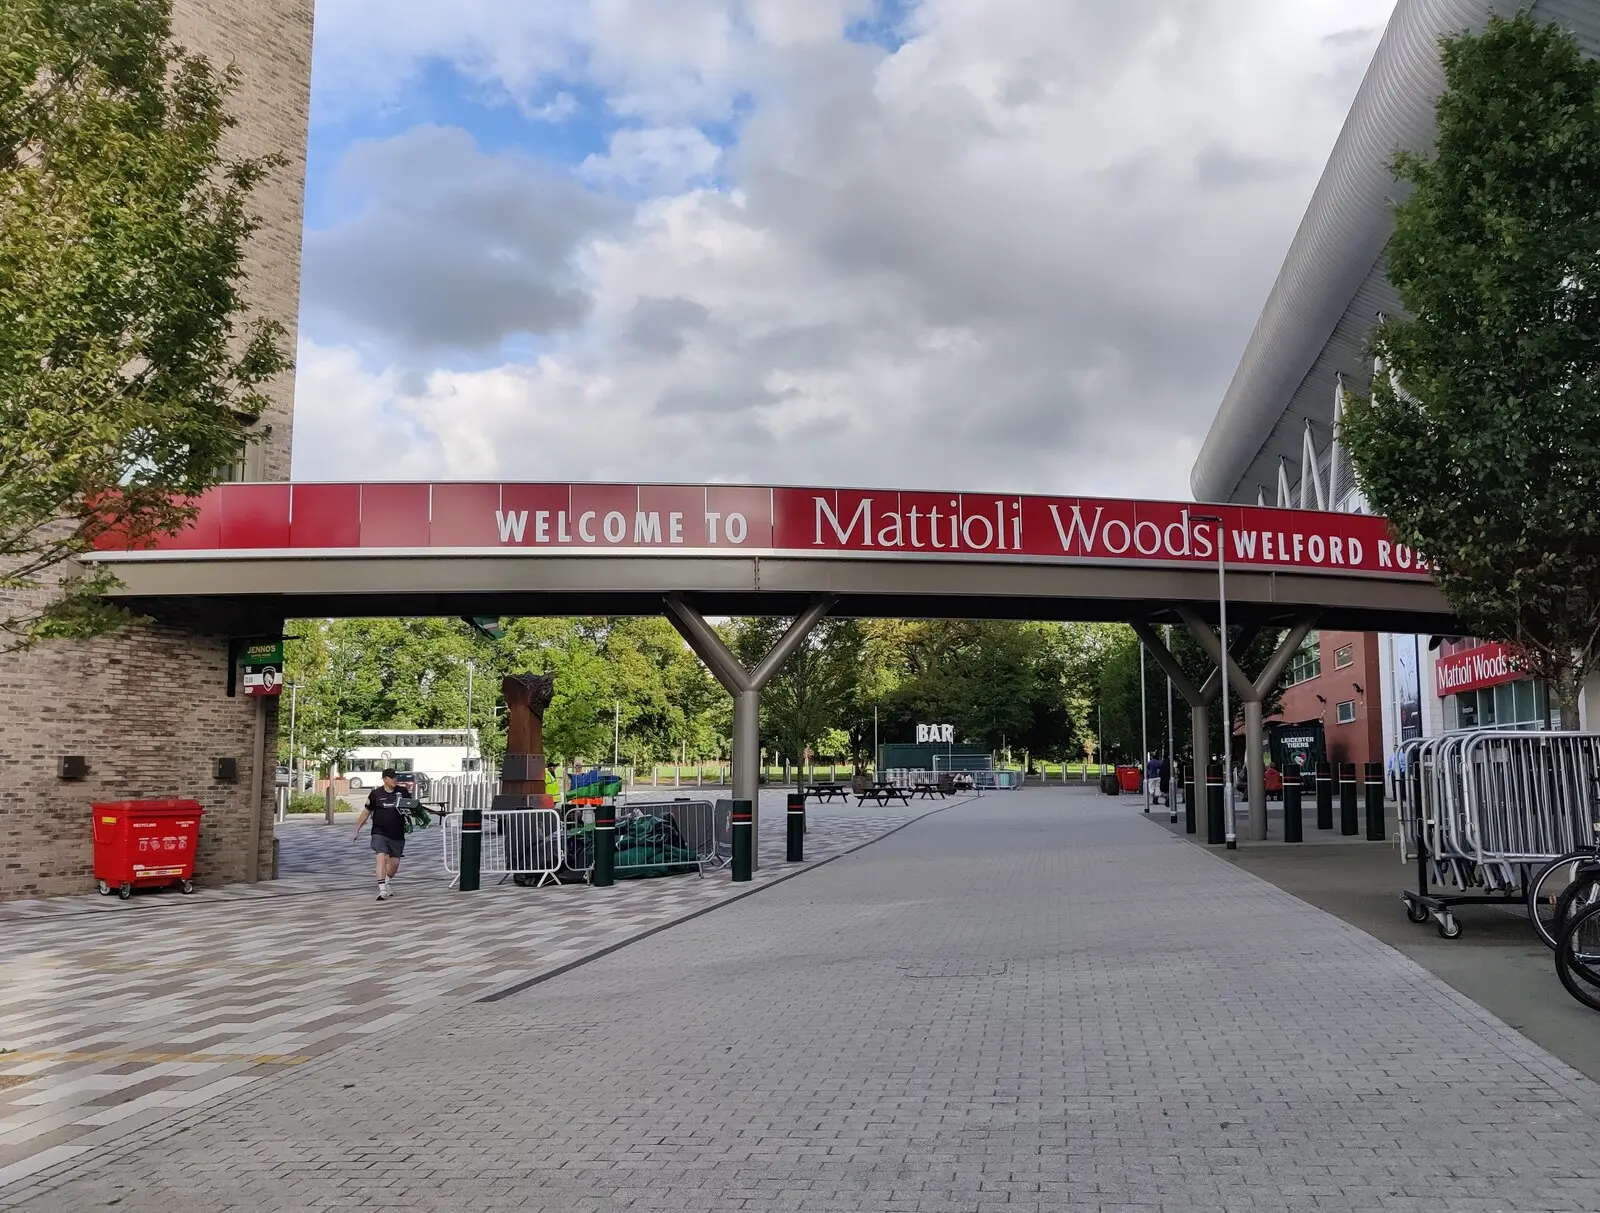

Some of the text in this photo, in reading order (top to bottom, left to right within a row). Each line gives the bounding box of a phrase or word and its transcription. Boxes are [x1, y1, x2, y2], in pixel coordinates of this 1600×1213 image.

[495, 496, 1441, 571] WELCOME TO Mattioli Woods WELFORD ROA
[247, 644, 276, 654] JENNO'S
[1438, 656, 1472, 690] Mattioli
[1473, 647, 1508, 681] Woods
[918, 723, 953, 743] BAR
[1280, 736, 1314, 744] LEICESTER
